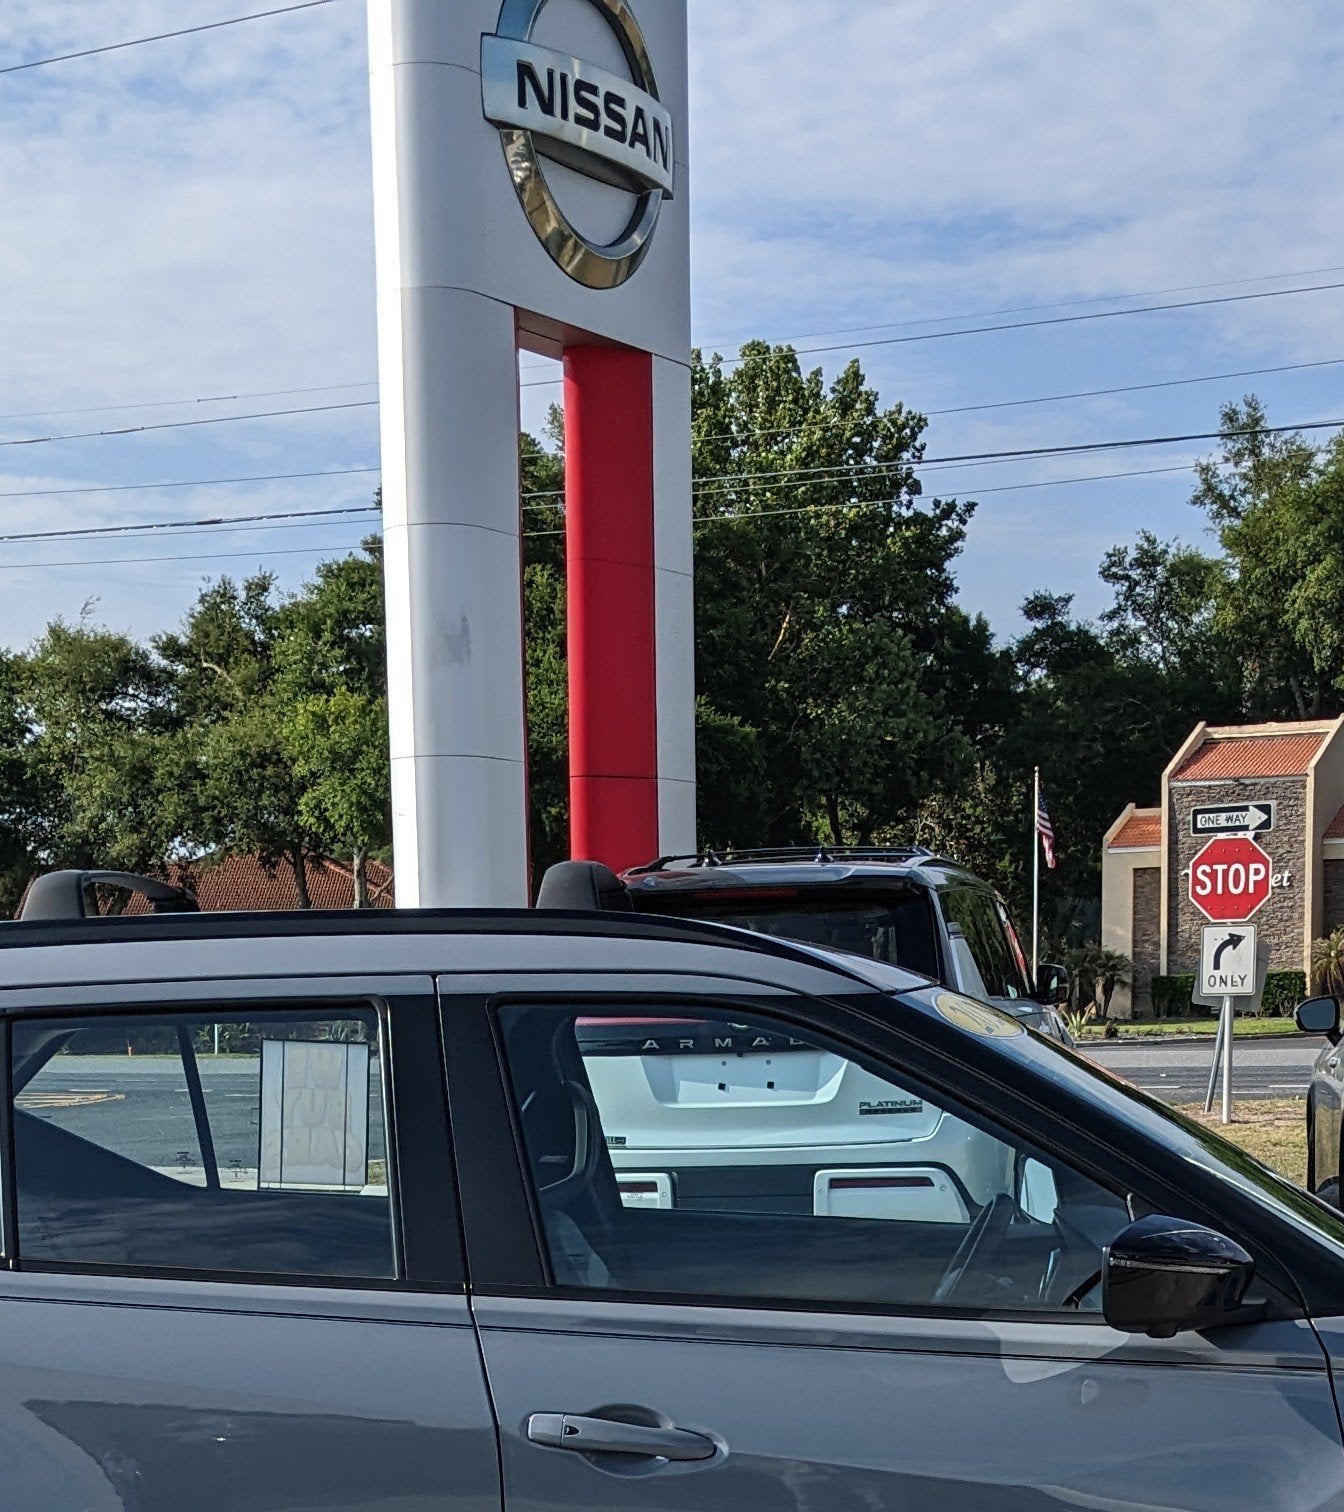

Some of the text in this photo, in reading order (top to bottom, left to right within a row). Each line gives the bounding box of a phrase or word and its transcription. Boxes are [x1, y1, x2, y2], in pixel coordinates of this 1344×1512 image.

[516, 58, 670, 174] NISSAN
[1200, 812, 1248, 827] ONE WAY
[1195, 863, 1266, 896] STOP
[1207, 974, 1248, 988] ONLY
[859, 1100, 923, 1108] PLATINUM
